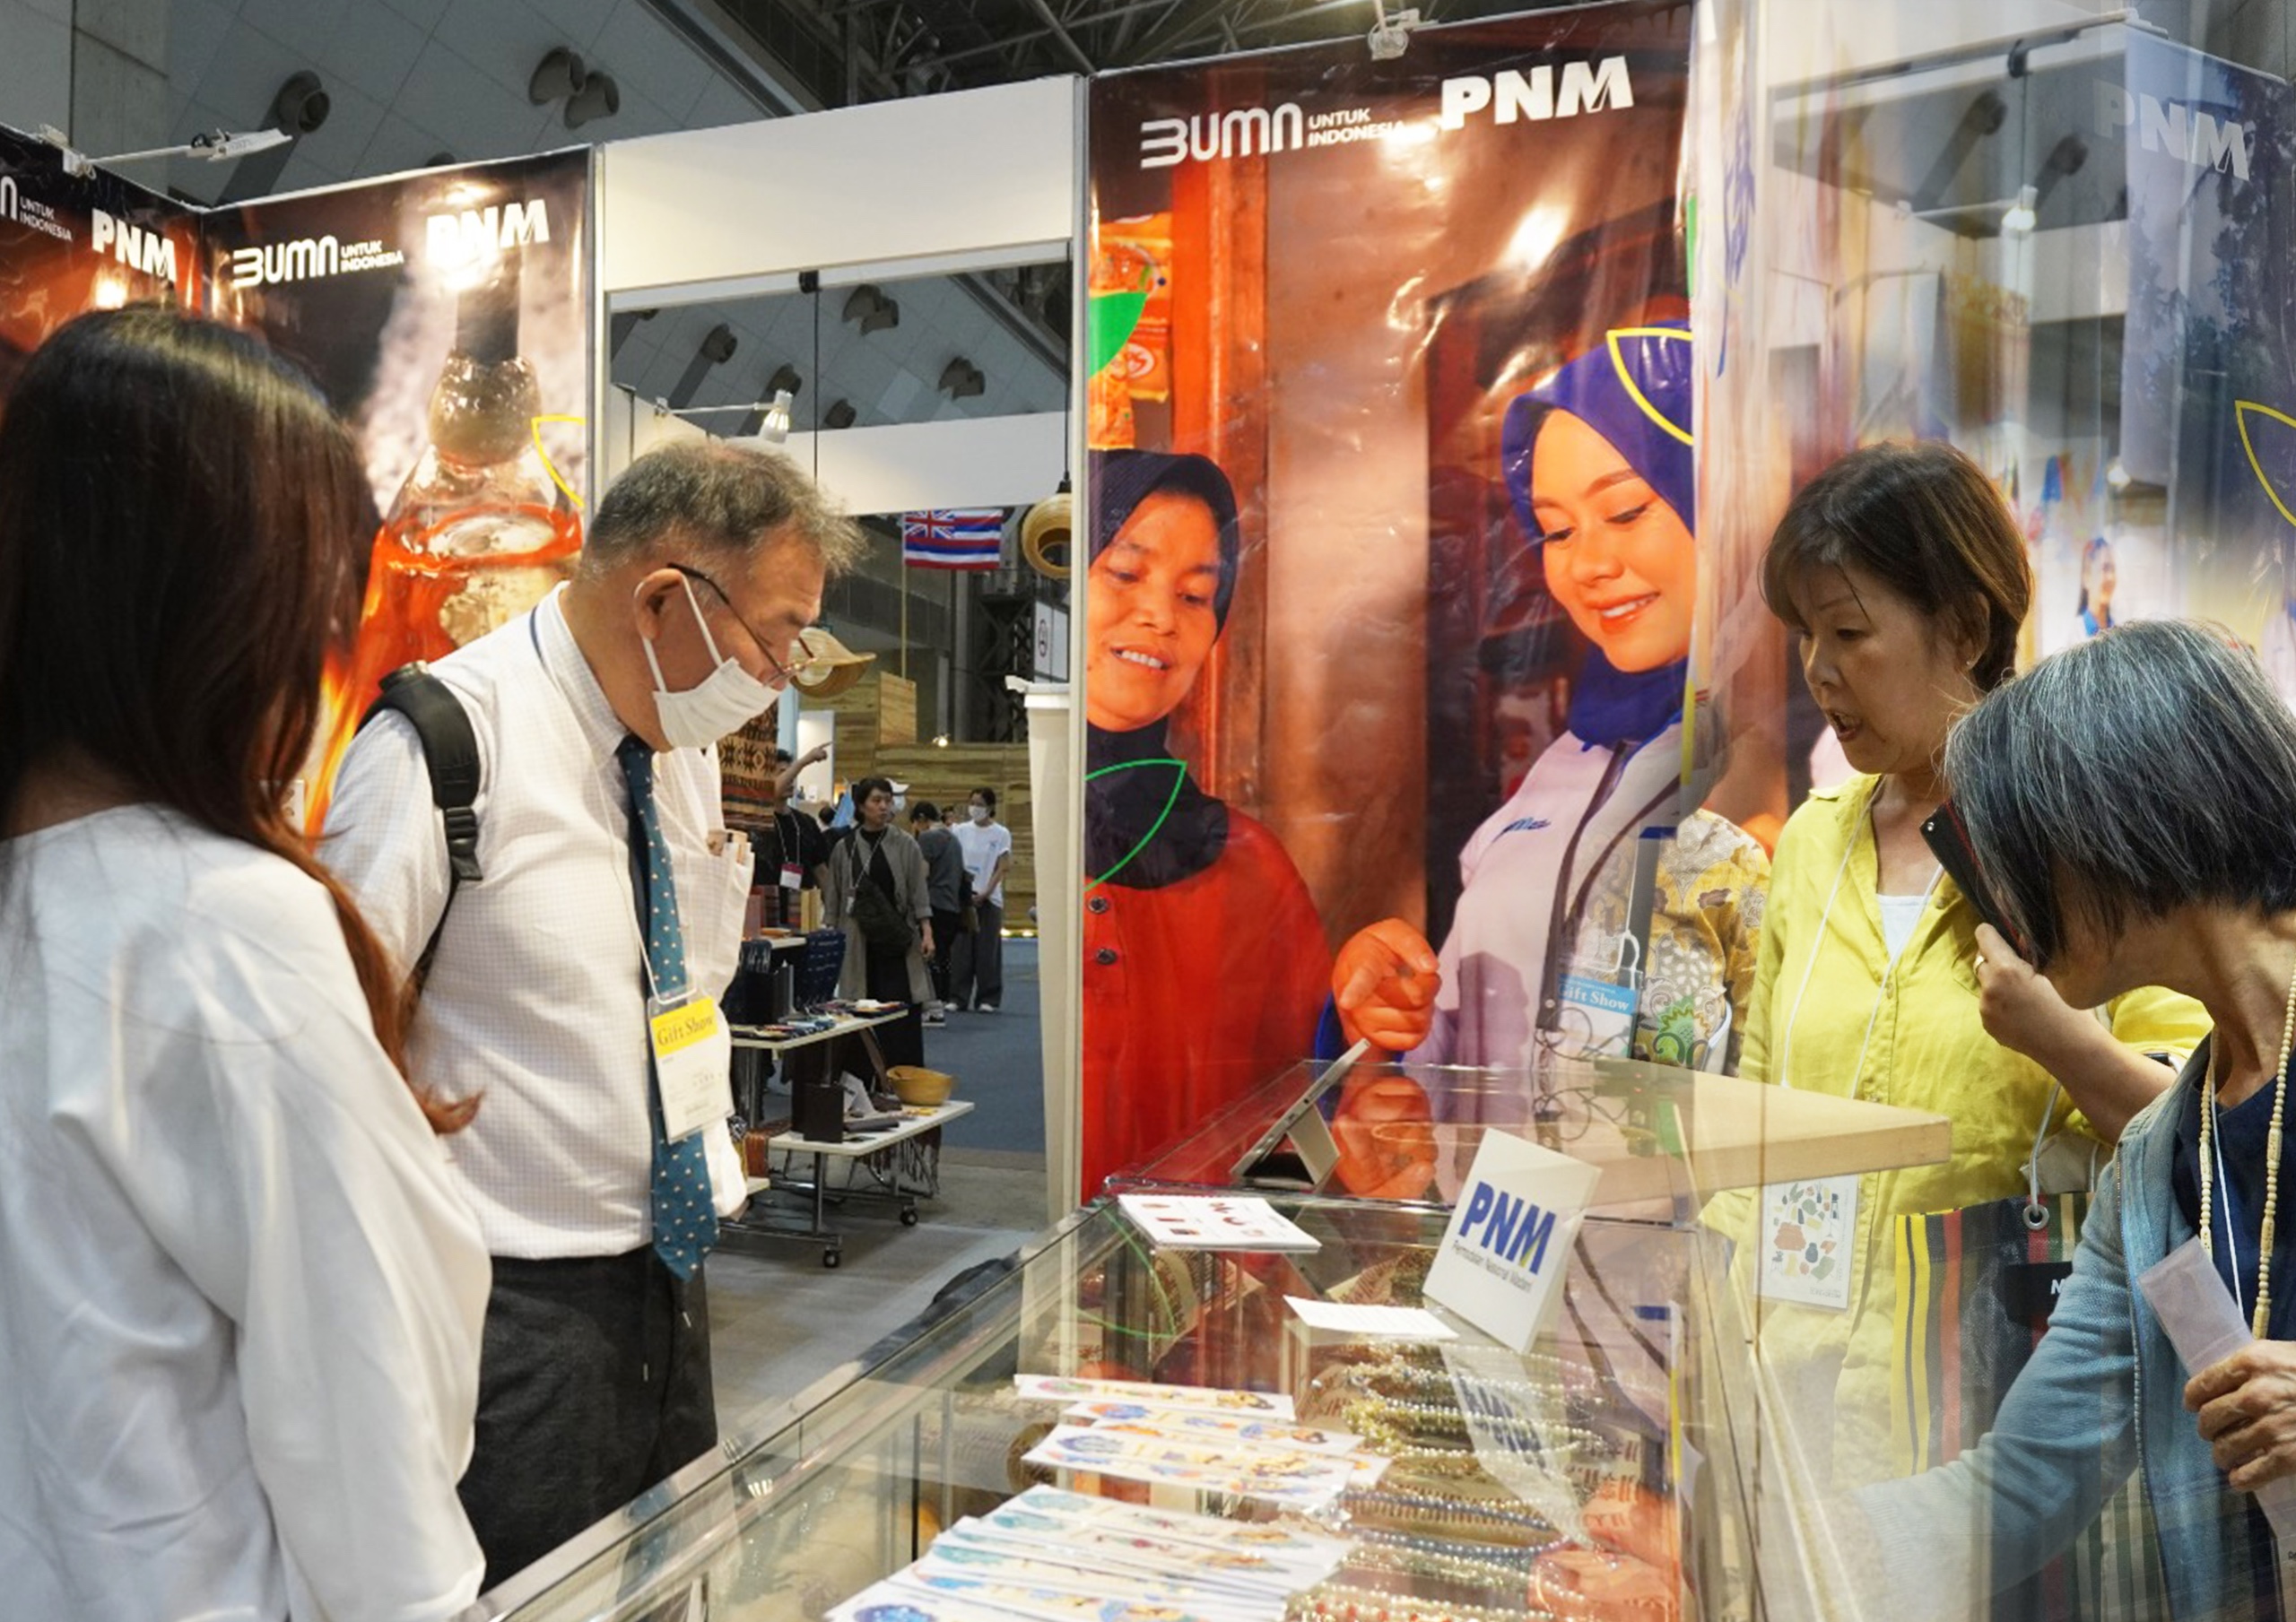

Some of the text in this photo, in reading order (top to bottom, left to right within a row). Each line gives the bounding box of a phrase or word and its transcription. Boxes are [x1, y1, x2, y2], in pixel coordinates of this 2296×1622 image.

[1440, 56, 1634, 131] PNM
[1308, 108, 1370, 130] UNTUK
[2092, 78, 2249, 180] PNM
[1308, 120, 1406, 148] INDONESIA
[20, 195, 55, 221] UNTUK
[20, 212, 73, 242] INDONESIA
[91, 207, 178, 283] PNM
[340, 239, 382, 259] UNTUK
[1589, 991, 1630, 1010] Show
[1457, 1181, 1556, 1275] PNM
